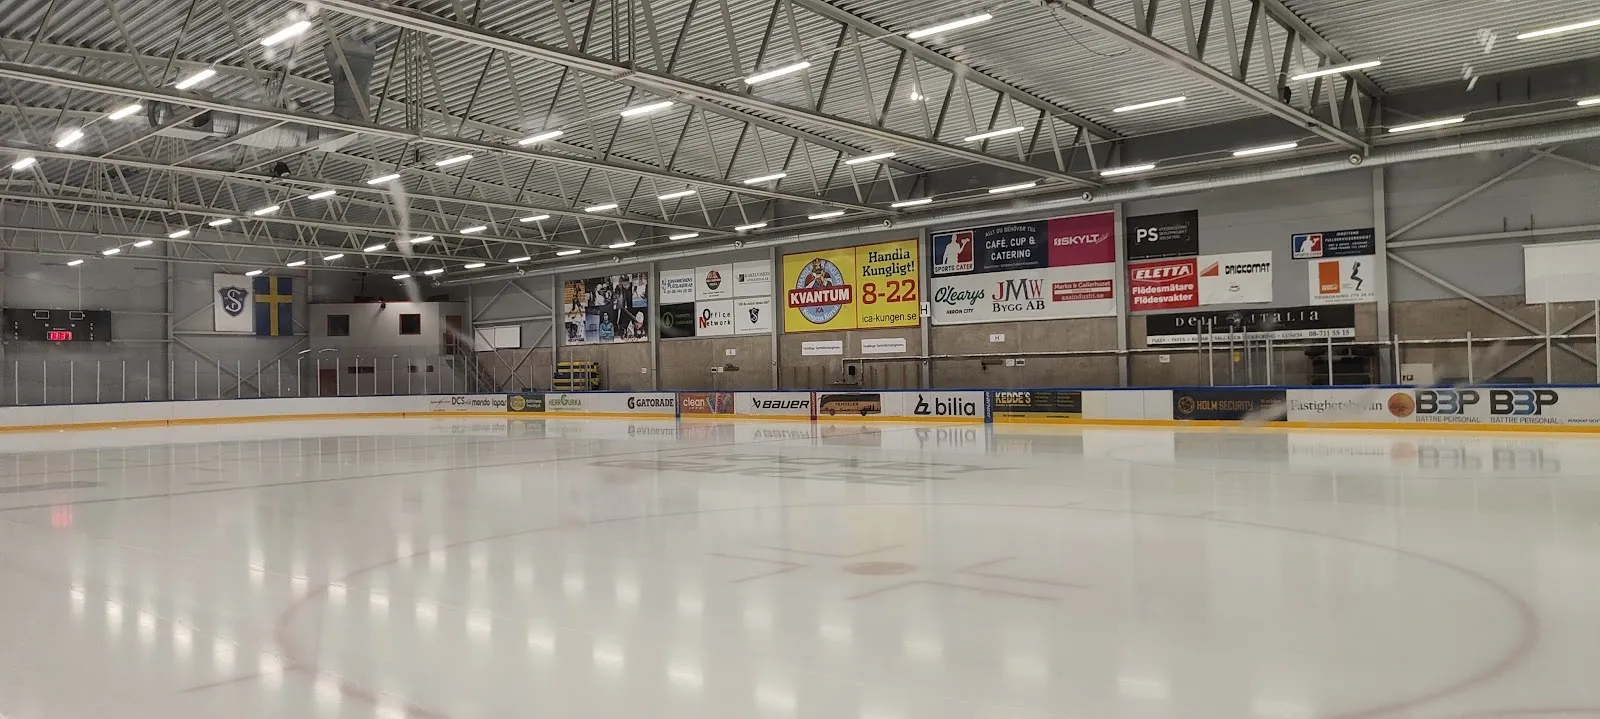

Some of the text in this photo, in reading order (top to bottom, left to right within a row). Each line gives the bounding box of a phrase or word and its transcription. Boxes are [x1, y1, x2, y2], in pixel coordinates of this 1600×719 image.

[1136, 227, 1158, 243] PS
[1010, 237, 1026, 247] CUP
[1028, 236, 1036, 245] &
[868, 248, 910, 263] Handla
[991, 249, 1031, 261] CATERING
[862, 261, 915, 278] Kungligt!
[935, 263, 973, 273] SPORTS CATER
[1136, 265, 1191, 279] ELETTA
[862, 279, 916, 304] 8-22
[991, 278, 1044, 301] JMW
[1132, 283, 1194, 295] Flödesmätare
[791, 288, 850, 305] KVANTUM
[1134, 293, 1193, 305] Flödesvakter
[993, 300, 1046, 312] BYGG AB
[702, 308, 731, 321] Office
[862, 312, 917, 324] ica-kungen.se
[699, 316, 731, 329] Network
[636, 399, 674, 407] GATORADE
[683, 397, 705, 407] clean
[995, 391, 1032, 404] KEDDE'S
[762, 400, 810, 409] BAUER
[935, 397, 976, 416] bilia
[1196, 400, 1218, 410] HOLM
[1219, 400, 1253, 411] SECURITY
